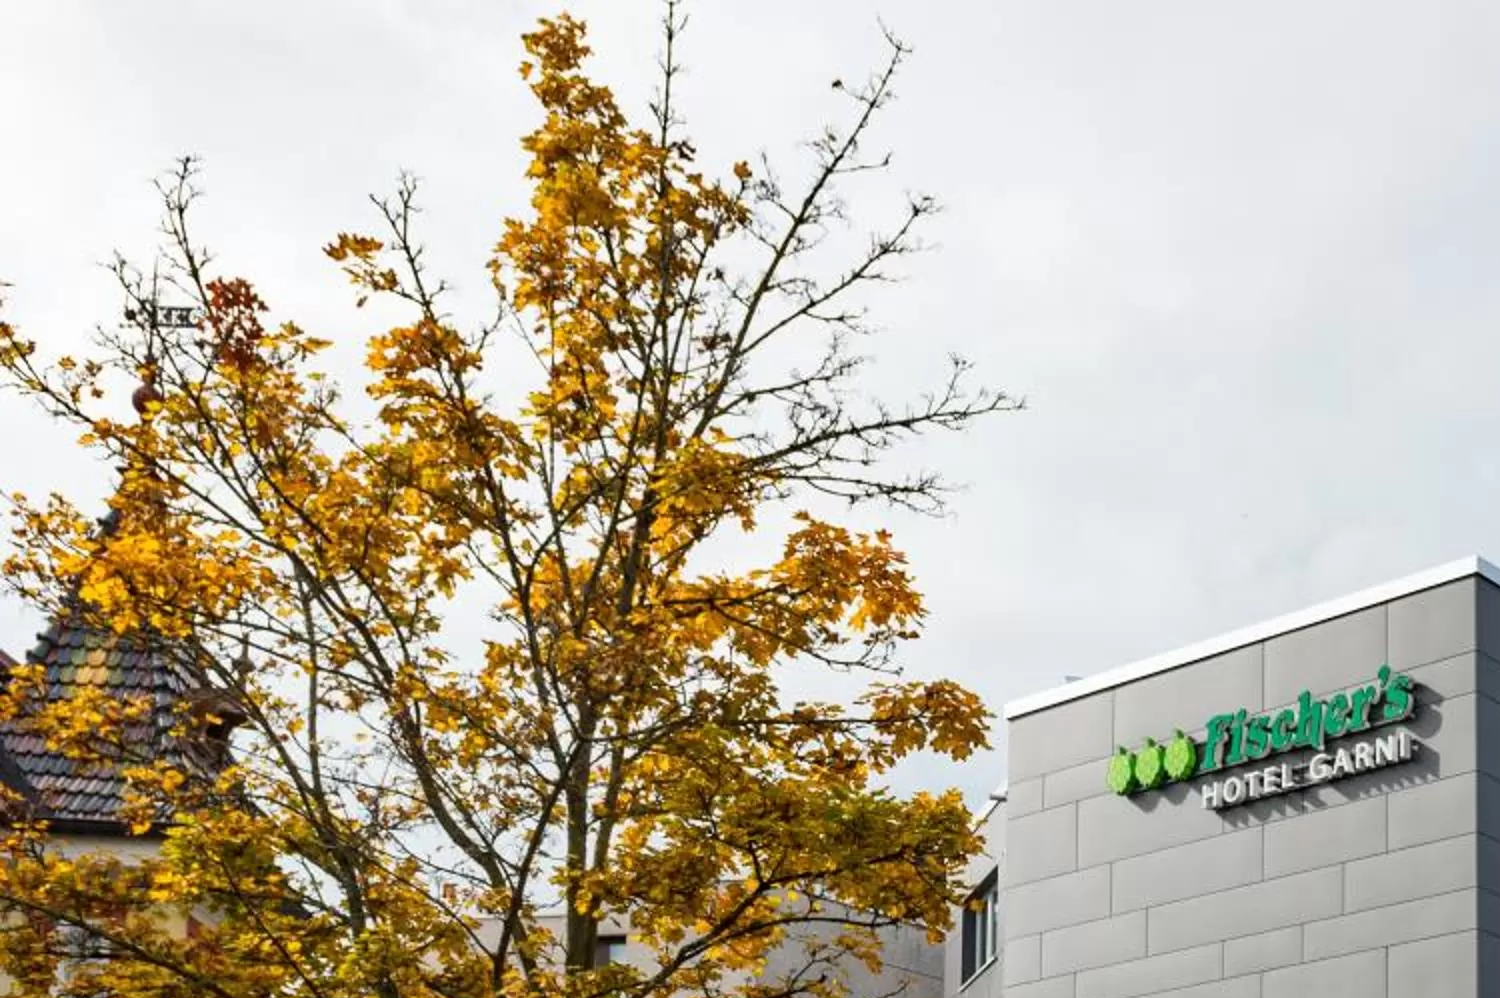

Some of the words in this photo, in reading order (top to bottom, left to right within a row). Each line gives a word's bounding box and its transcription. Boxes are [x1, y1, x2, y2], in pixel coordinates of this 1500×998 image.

[1202, 664, 1414, 769] Fischer's
[1202, 762, 1295, 809] HOTEL
[1308, 730, 1414, 783] GARNI
